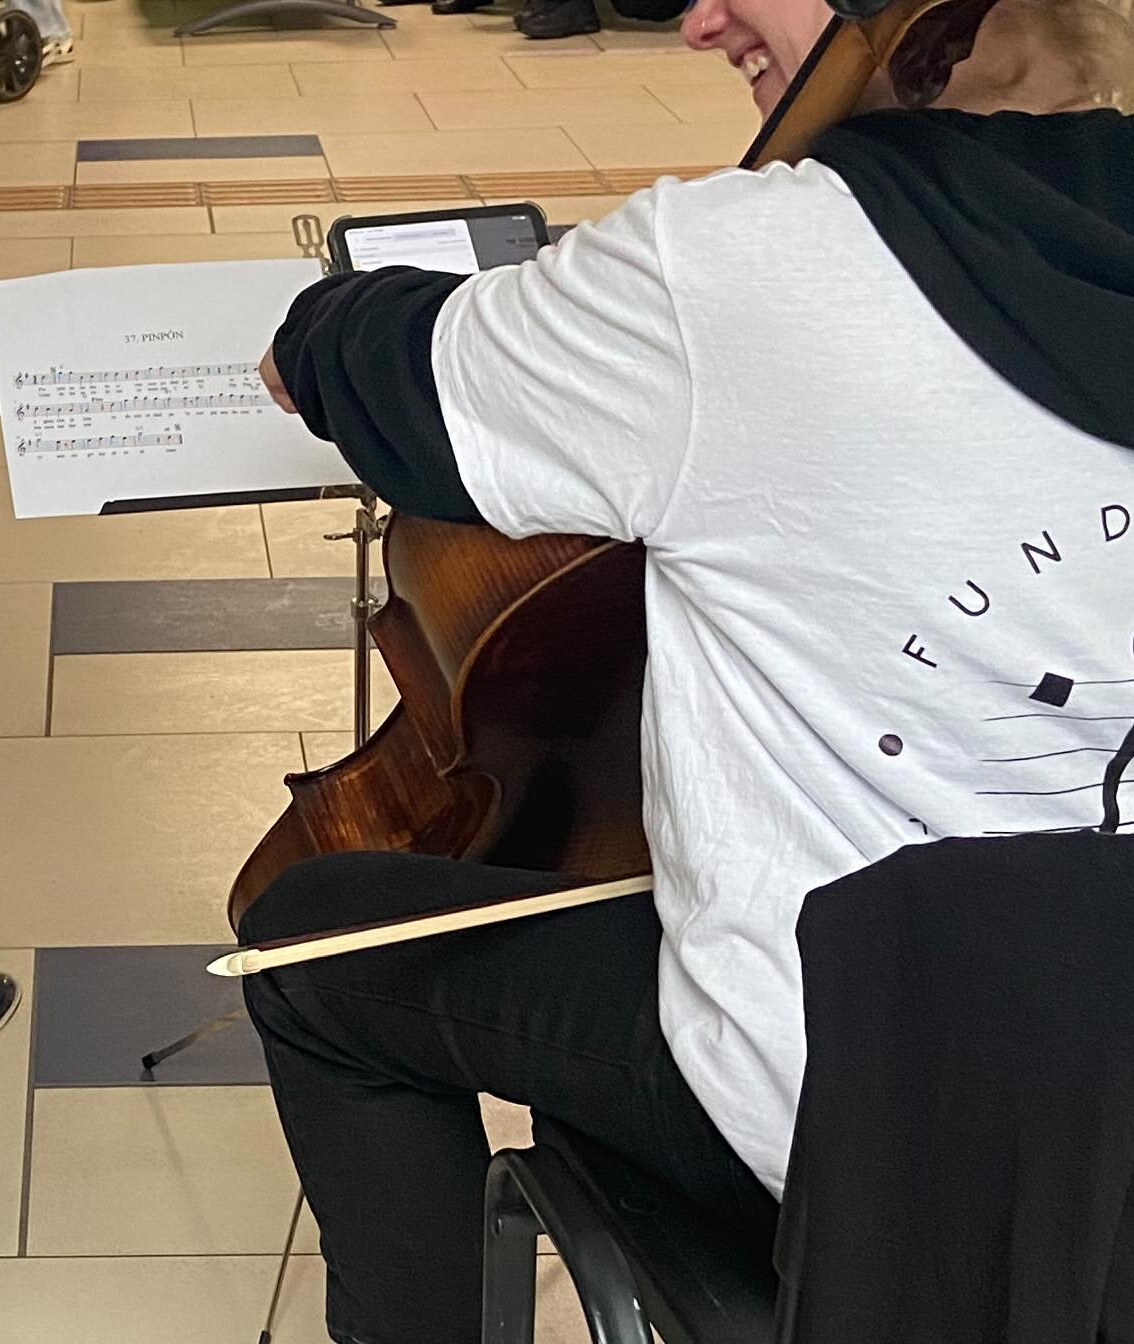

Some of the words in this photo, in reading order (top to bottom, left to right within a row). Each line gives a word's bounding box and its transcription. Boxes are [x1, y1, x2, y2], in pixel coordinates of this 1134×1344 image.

[124, 335, 139, 343] 37.
[141, 330, 184, 342] PINPÓN
[902, 503, 1131, 669] FUND
